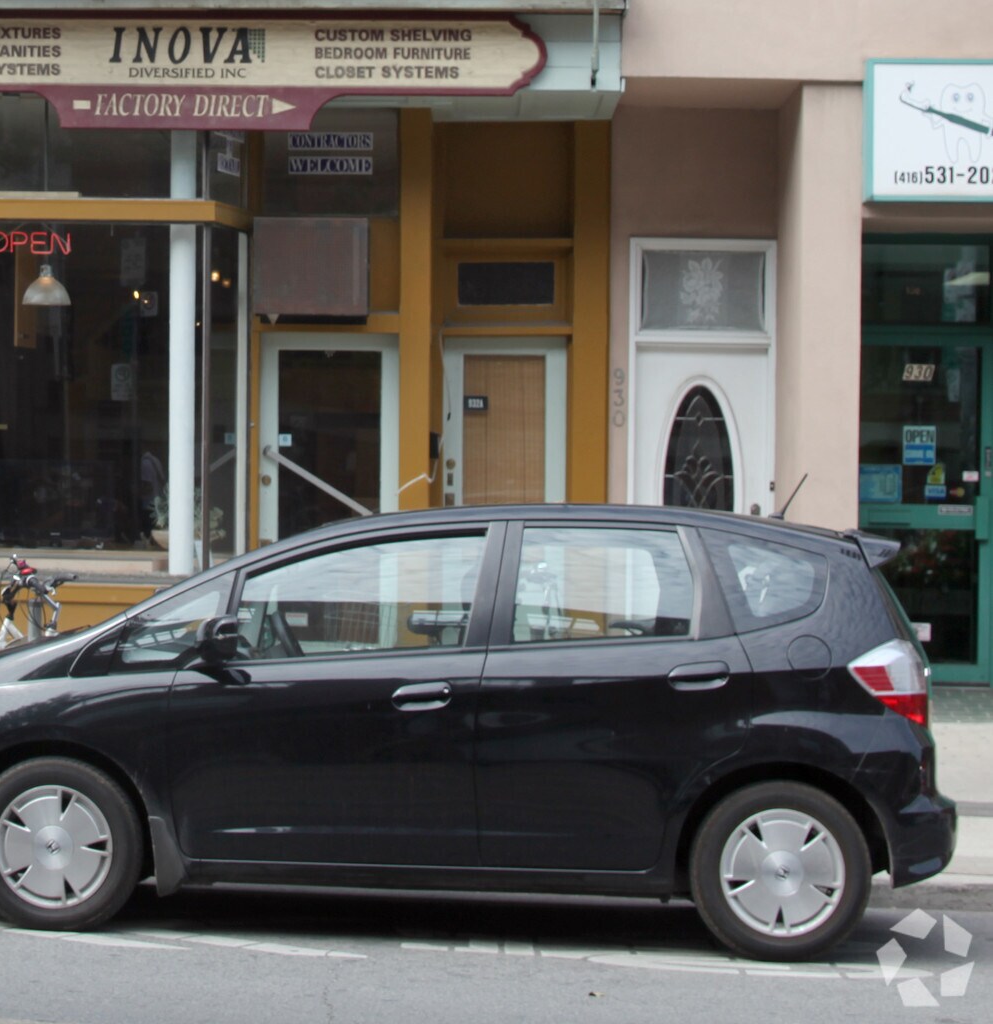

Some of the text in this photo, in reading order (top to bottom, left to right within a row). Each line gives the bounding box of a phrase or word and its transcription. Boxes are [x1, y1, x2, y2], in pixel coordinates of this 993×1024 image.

[314, 28, 473, 42] CUSTOM SHELVING
[109, 26, 252, 64] INOVA
[314, 47, 472, 61] BEDROOM FURNITURE
[128, 67, 247, 79] DIVERSIFIED INC
[314, 65, 460, 79] CLOSET SYSTEMS
[94, 93, 269, 118] FACTORY DIRECT
[289, 134, 372, 148] CONTRACTORS
[289, 158, 372, 173] WELCOME
[905, 364, 934, 379] 930
[613, 368, 626, 427] 930
[905, 430, 934, 443] OPEN
